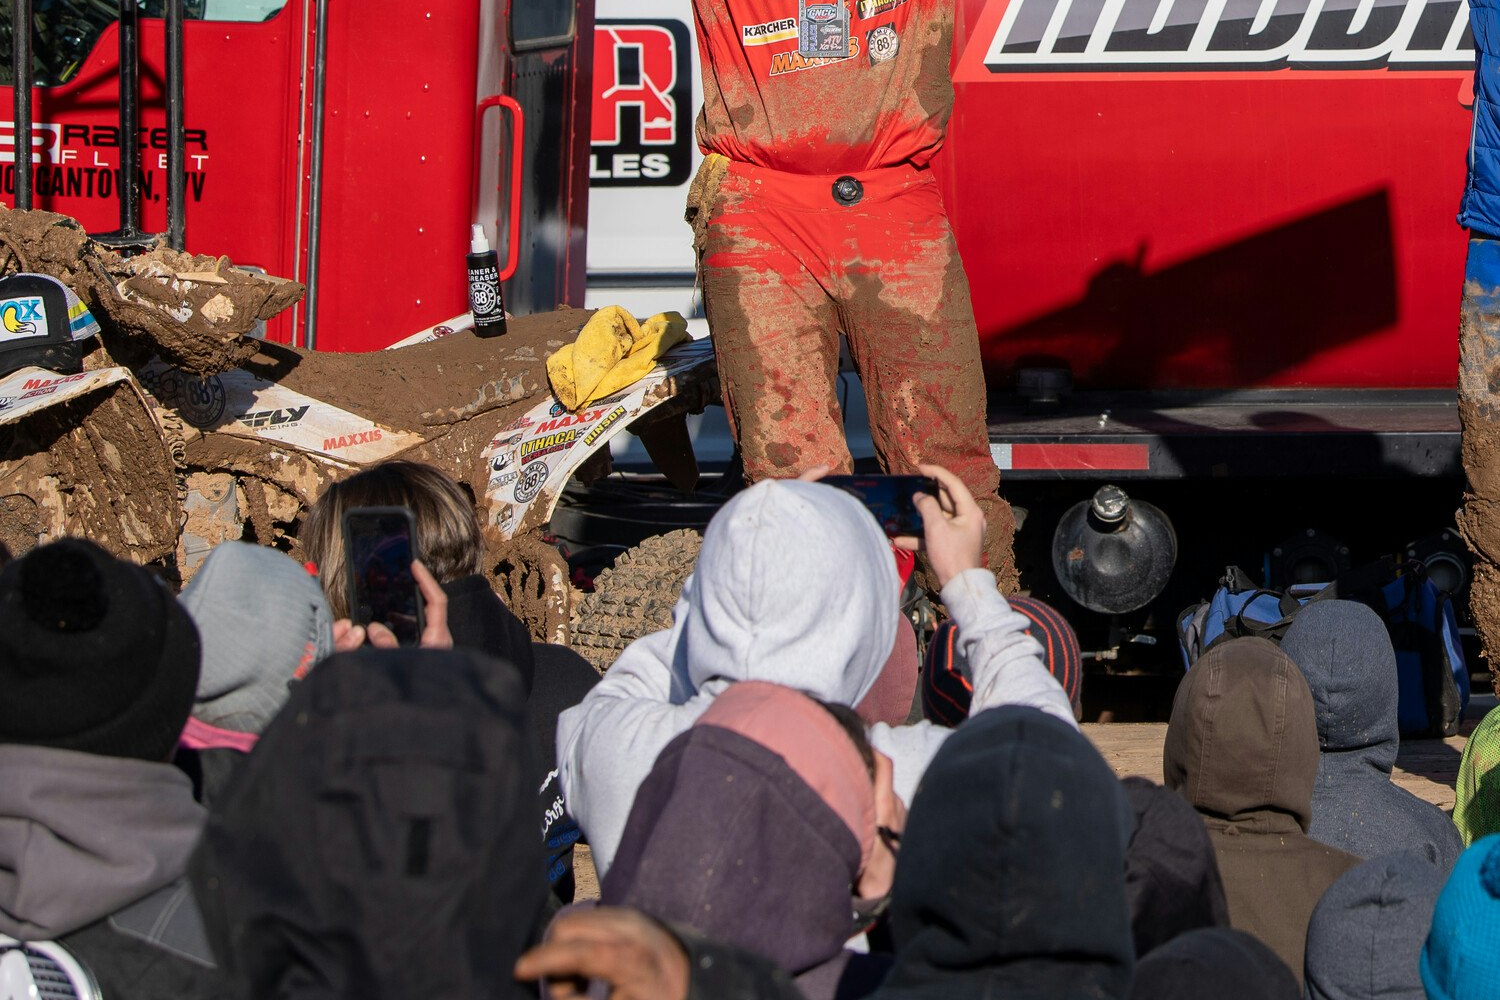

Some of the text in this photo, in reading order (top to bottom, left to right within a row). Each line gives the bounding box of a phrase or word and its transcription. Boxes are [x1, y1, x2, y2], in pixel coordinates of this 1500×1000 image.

[809, 8, 836, 17] GNCC
[744, 19, 796, 37] KÄRCHER
[823, 35, 842, 45] ATV
[877, 37, 890, 51] 88
[770, 37, 860, 75] MAS
[61, 149, 209, 170] FLET
[0, 163, 160, 204] OGANTON,
[474, 291, 488, 304] 88
[22, 372, 89, 390] MAXXIS
[240, 405, 311, 428] FLY
[583, 405, 627, 447] HINSON
[323, 429, 383, 451] MAXXIS
[520, 428, 577, 456] ITHACA
[524, 471, 538, 491] 88
